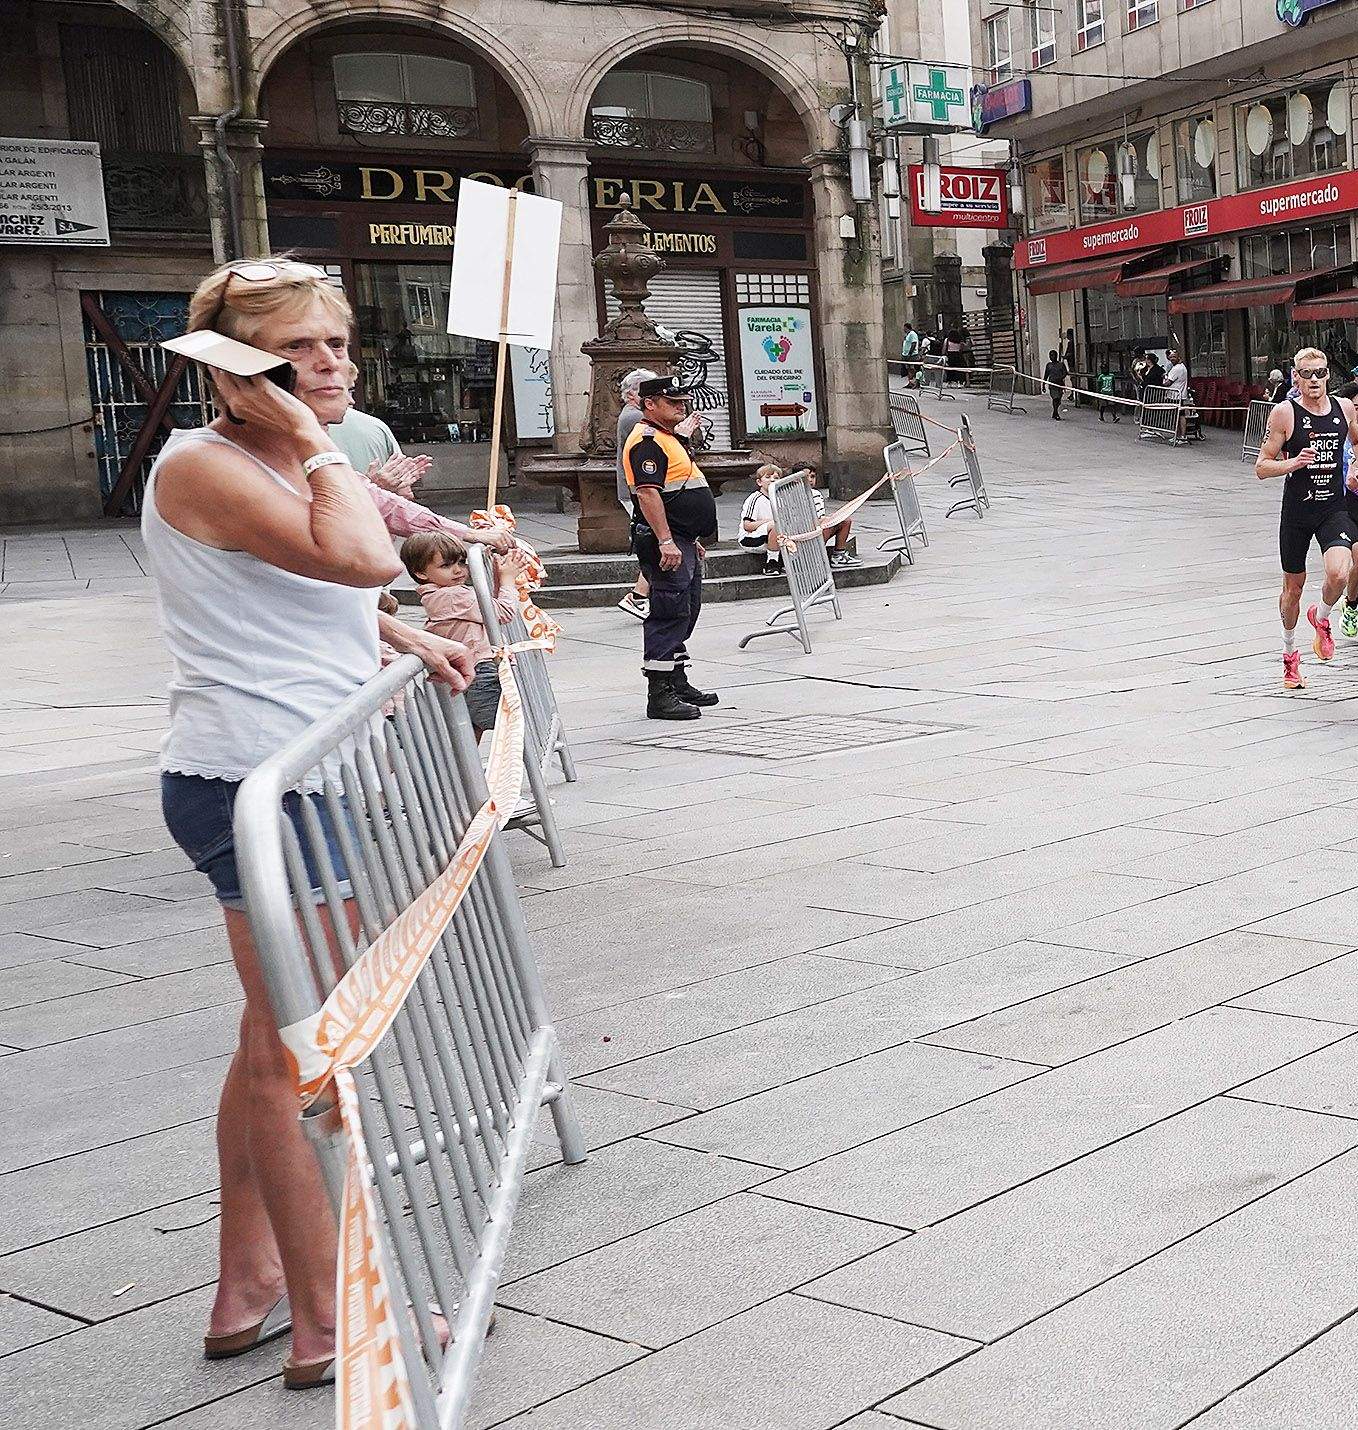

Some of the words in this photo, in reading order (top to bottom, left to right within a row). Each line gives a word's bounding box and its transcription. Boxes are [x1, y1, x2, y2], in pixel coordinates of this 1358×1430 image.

[917, 89, 960, 101] FARMACIA
[1260, 184, 1339, 216] supermercado
[953, 213, 1000, 222] multicentro
[1184, 210, 1207, 227] FROIZ
[369, 223, 456, 246] PERFUMER
[1083, 224, 1139, 250] supermercado
[748, 323, 782, 332] Varela
[1310, 440, 1338, 450] PRICE
[1314, 452, 1333, 461] GBR
